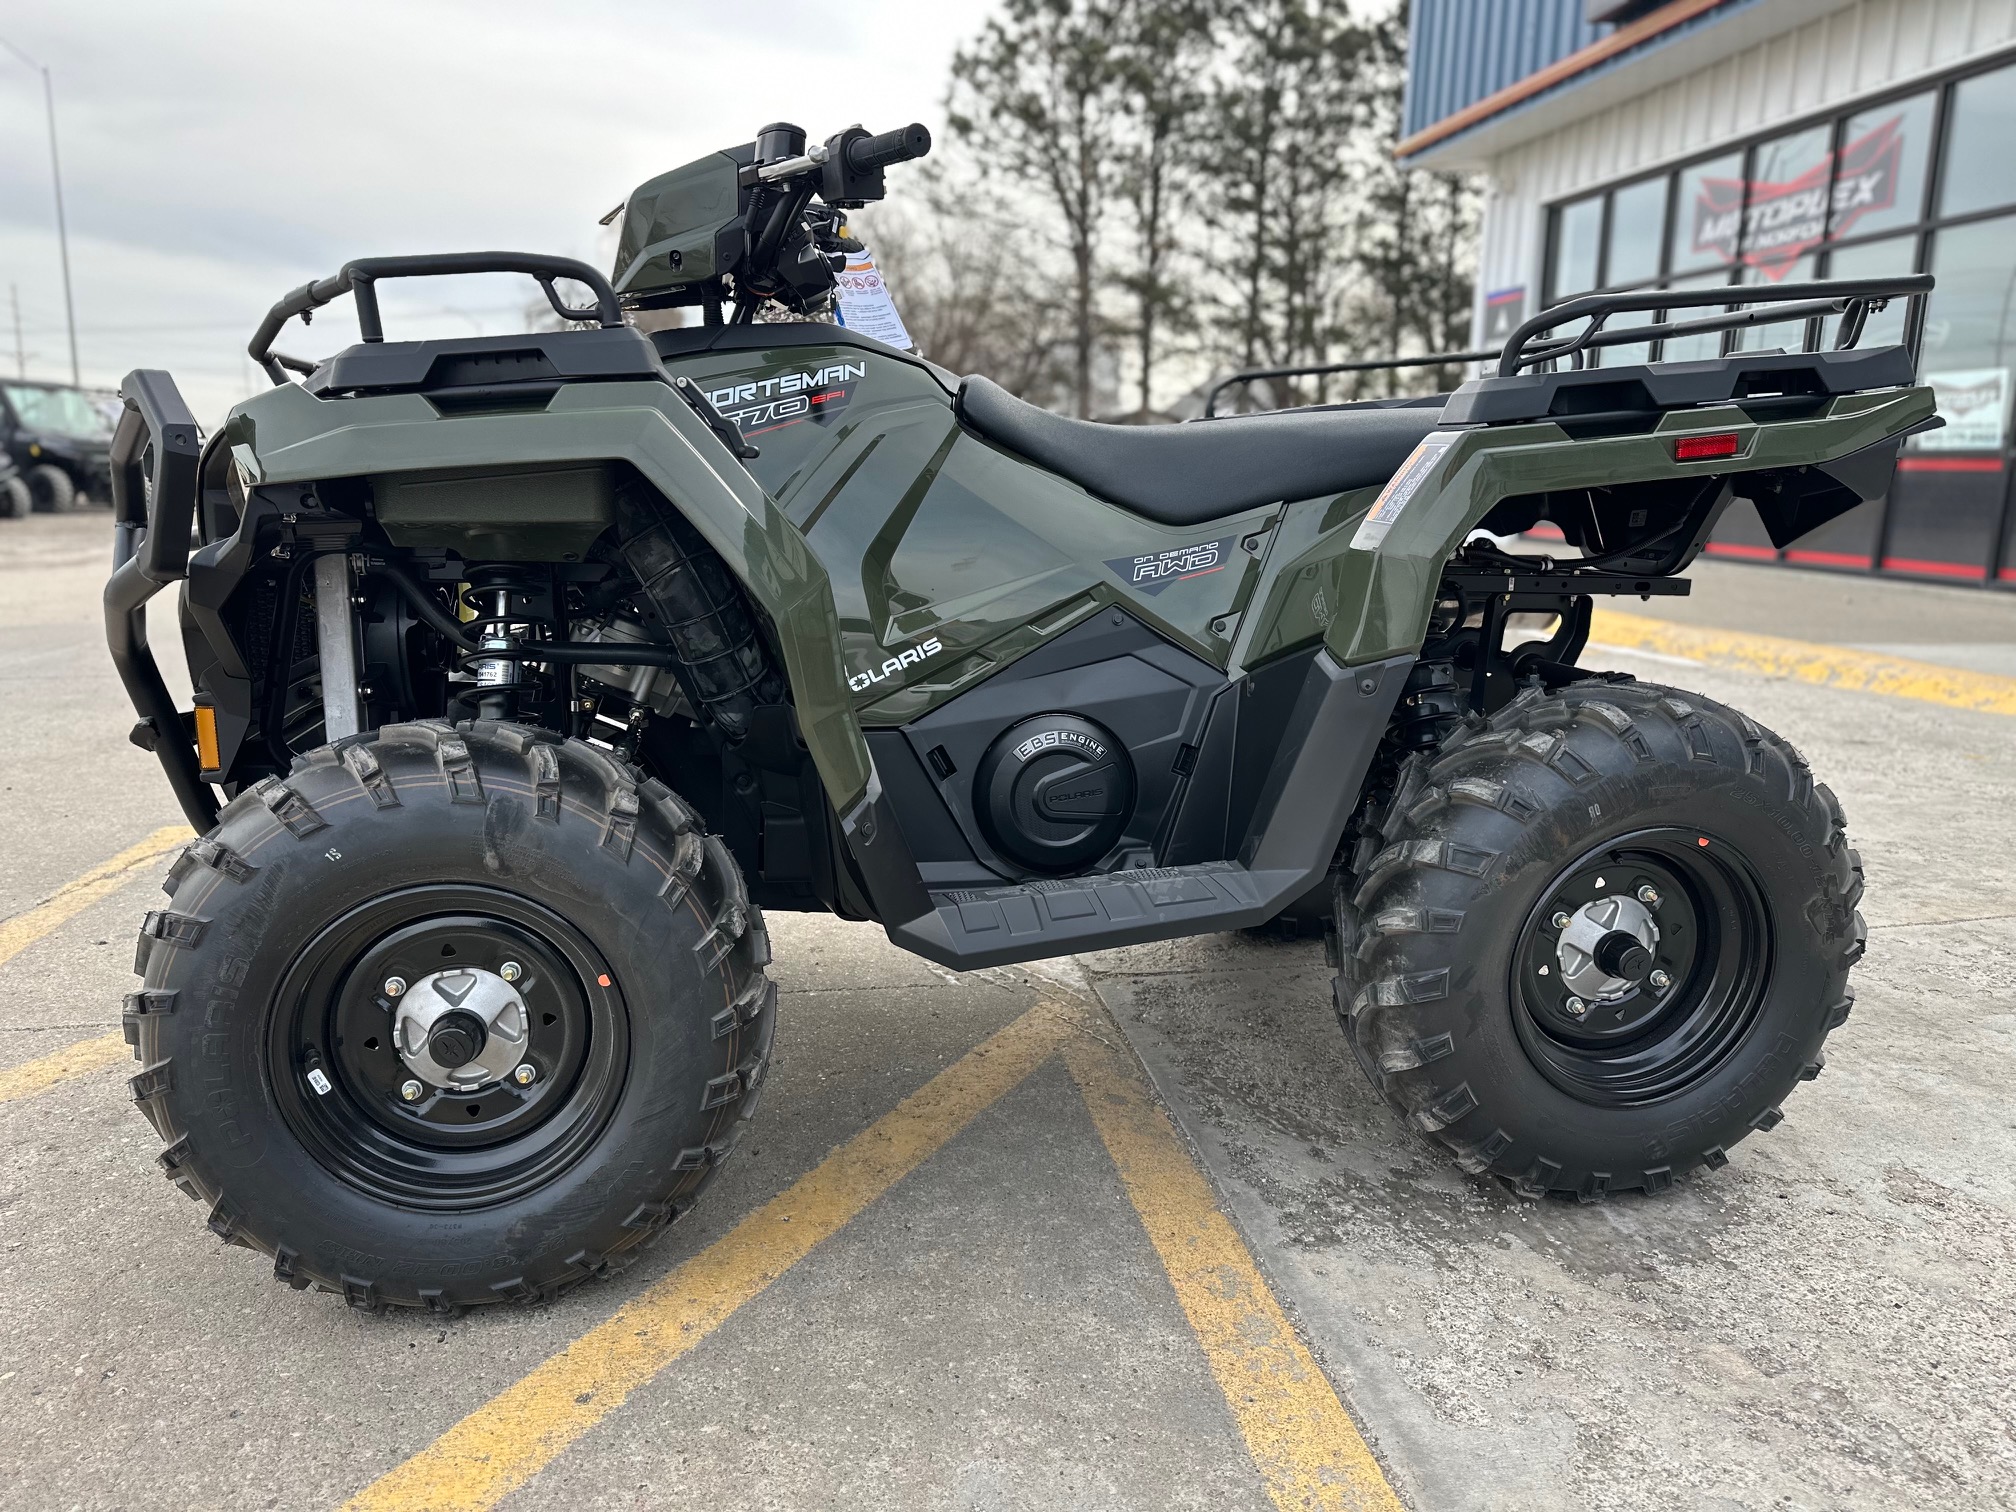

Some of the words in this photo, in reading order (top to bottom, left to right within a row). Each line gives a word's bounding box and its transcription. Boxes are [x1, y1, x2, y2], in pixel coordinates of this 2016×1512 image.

[704, 361, 866, 408] ORTSMAN
[811, 390, 846, 405] EFI
[1133, 549, 1219, 582] AWD
[1134, 555, 1154, 564] ON
[1159, 541, 1219, 560] DEMAND
[846, 636, 943, 692] OLARIS
[1017, 732, 1056, 758] EBS
[1060, 732, 1105, 755] ENGINE
[1048, 788, 1105, 803] POLARIS
